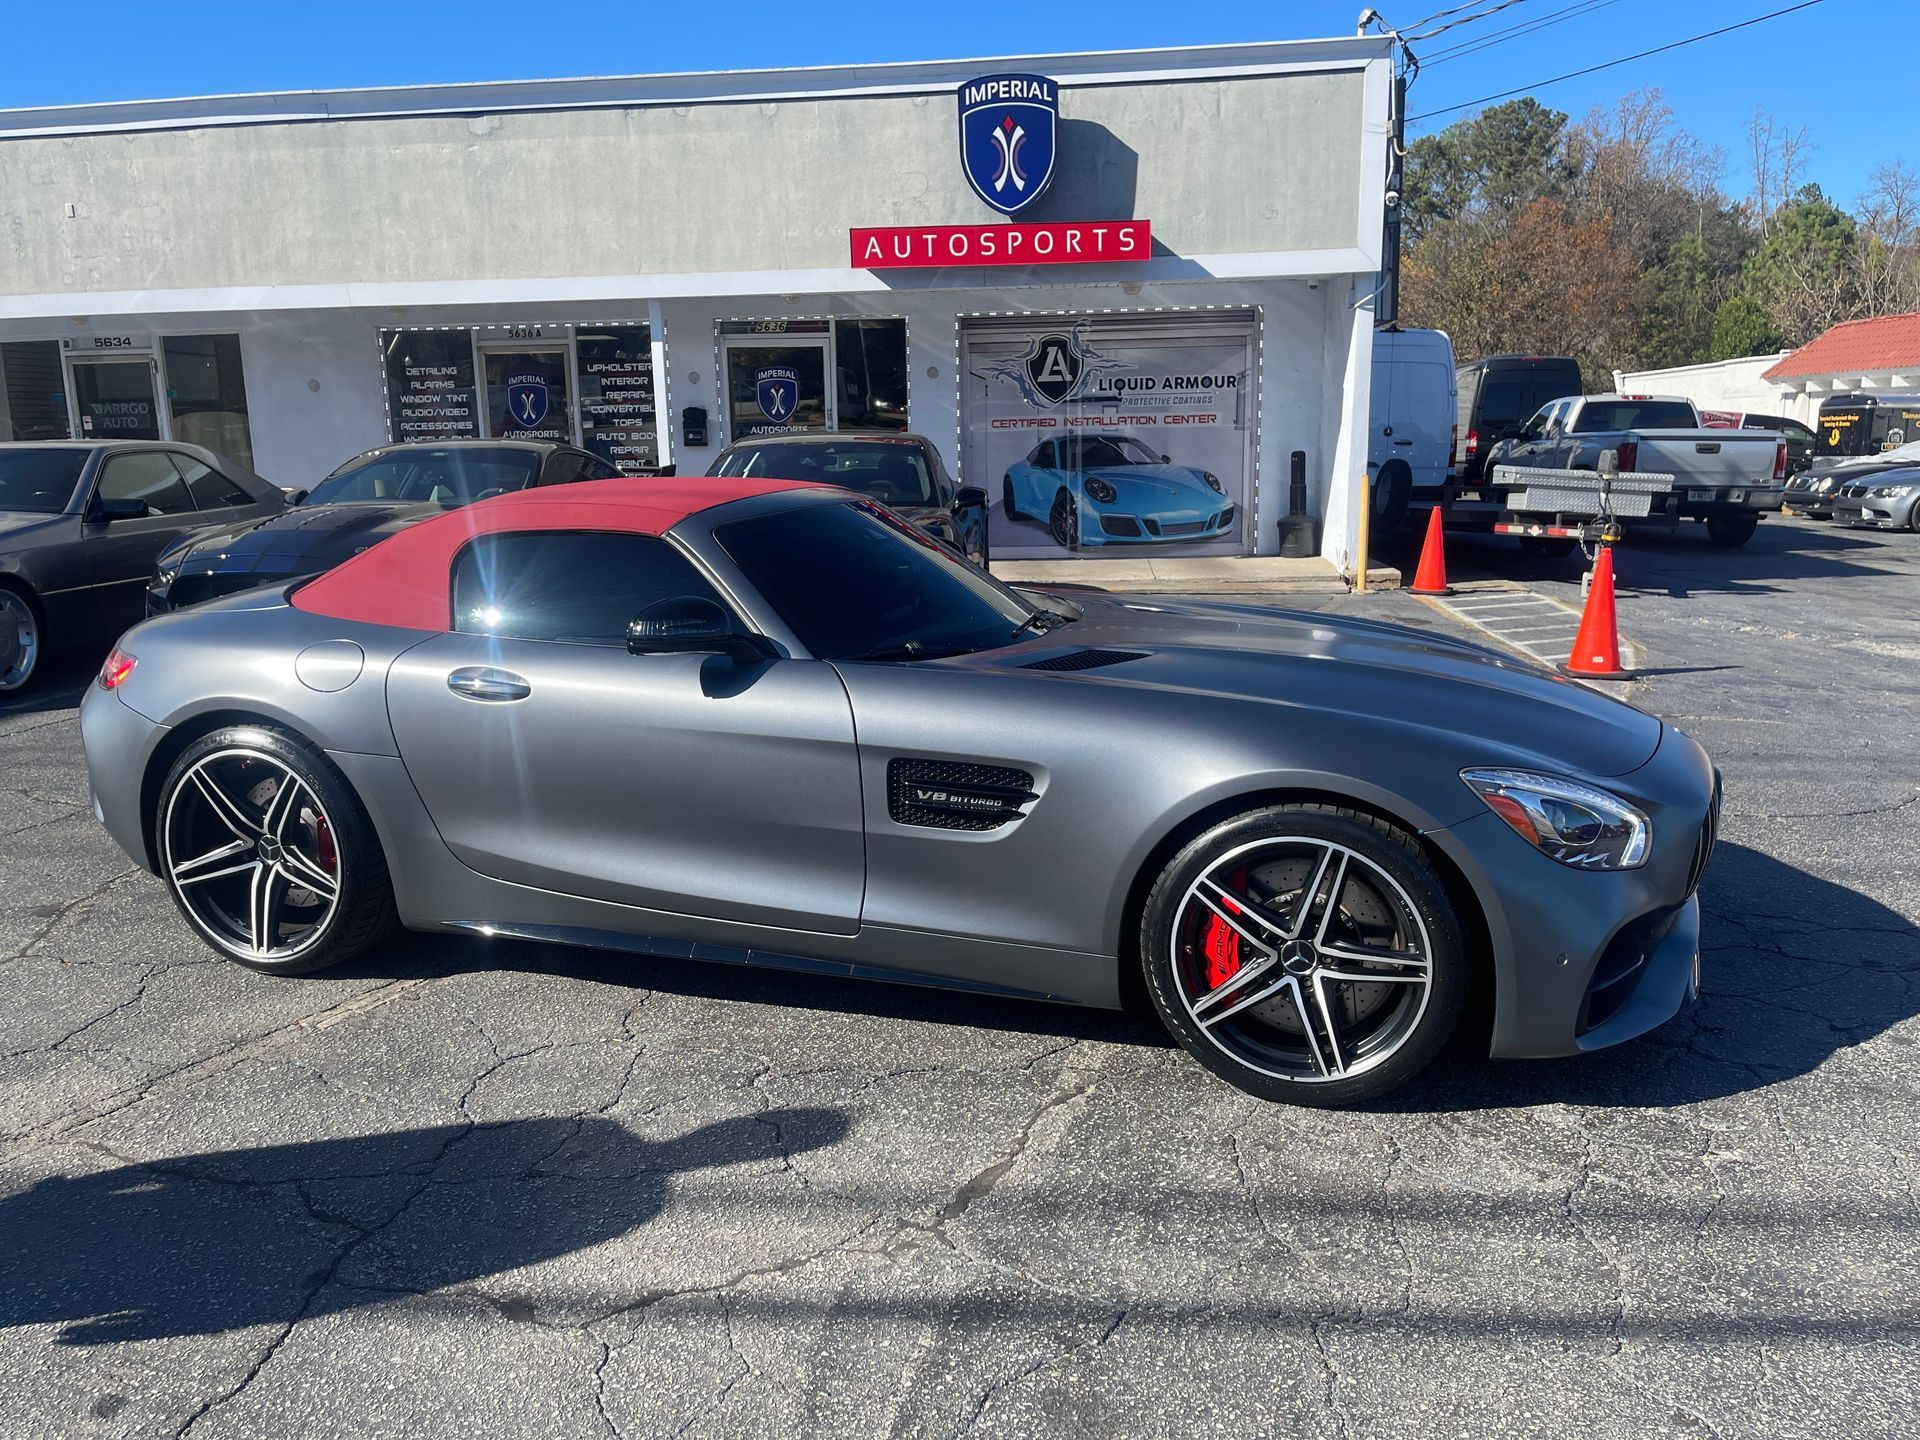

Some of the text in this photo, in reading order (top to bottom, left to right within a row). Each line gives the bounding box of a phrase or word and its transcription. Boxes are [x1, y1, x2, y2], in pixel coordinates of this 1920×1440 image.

[965, 80, 1053, 105] IMPERIAL
[864, 228, 1136, 260] AUTOSPORTS
[757, 321, 785, 332] 5636
[508, 329, 542, 338] 5636 A
[94, 337, 132, 348] 5634
[405, 366, 457, 376] DETAILING
[758, 369, 796, 380] IMPERIAL
[410, 380, 455, 389] ALARMS
[508, 375, 546, 385] IMPERIAL
[601, 376, 649, 386] INTERIOR
[1099, 375, 1238, 397] LIQUID ARMOUR
[400, 394, 468, 404] WINDOW TINT
[606, 390, 646, 399] REPAIR
[1122, 395, 1213, 406] PROTECTIVE COATINGS
[402, 407, 469, 417] AUDIO/VIDEO
[103, 416, 138, 429] AUTO
[400, 421, 473, 431] ACCESSORIES
[613, 418, 643, 427] TOPS
[991, 414, 1217, 429] CERTIFIED INSTALLATION CENTER
[502, 430, 560, 439] AUTOSPORTS
[750, 425, 808, 434] AUTOSPORTS
[596, 432, 626, 441] AUTO
[610, 445, 649, 454] REPAIR
[917, 789, 1003, 807] V8 BITURBO
